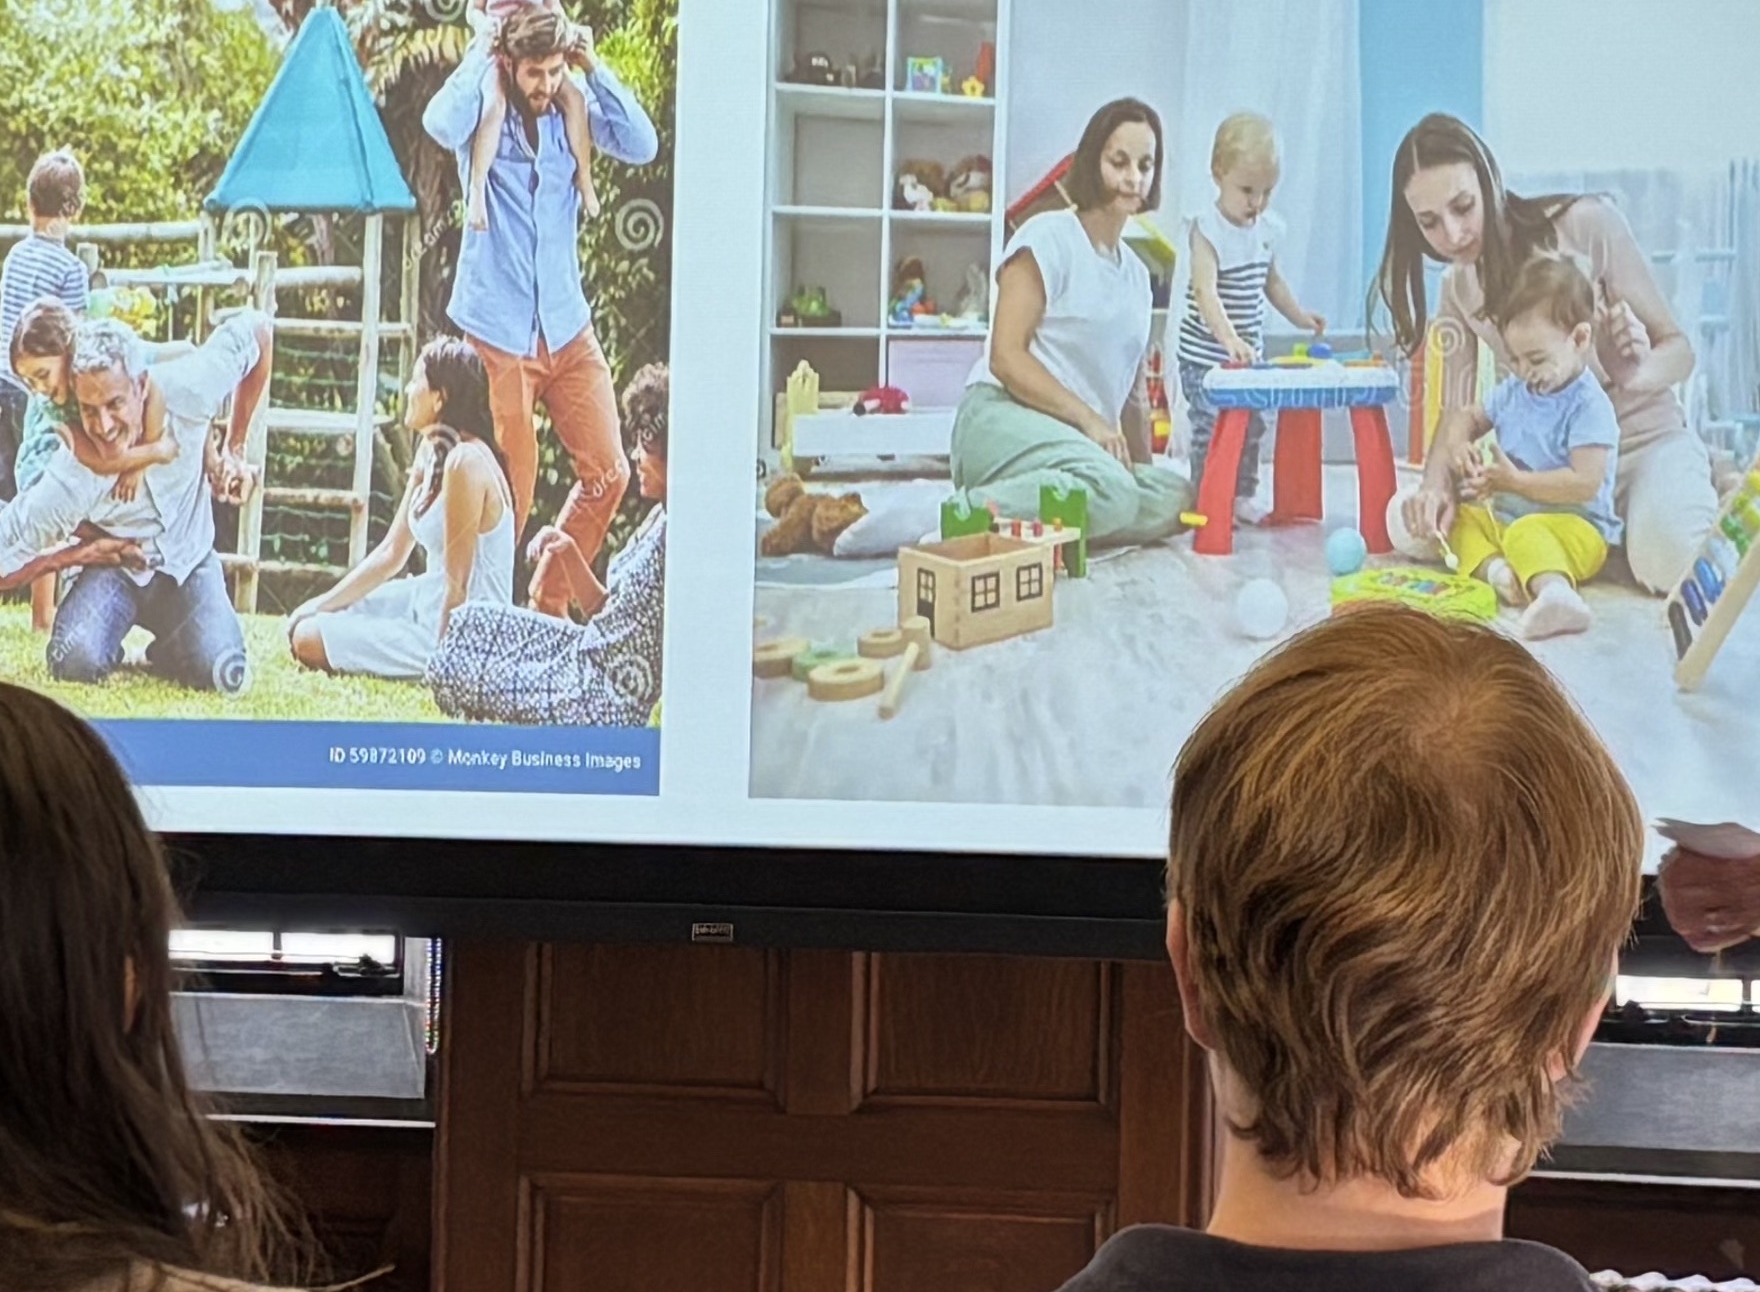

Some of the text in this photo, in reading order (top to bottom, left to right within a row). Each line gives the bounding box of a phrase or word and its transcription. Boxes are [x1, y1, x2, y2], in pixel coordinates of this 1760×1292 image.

[448, 748, 508, 770] Monkey
[511, 750, 581, 768] Business
[585, 752, 641, 773] Images
